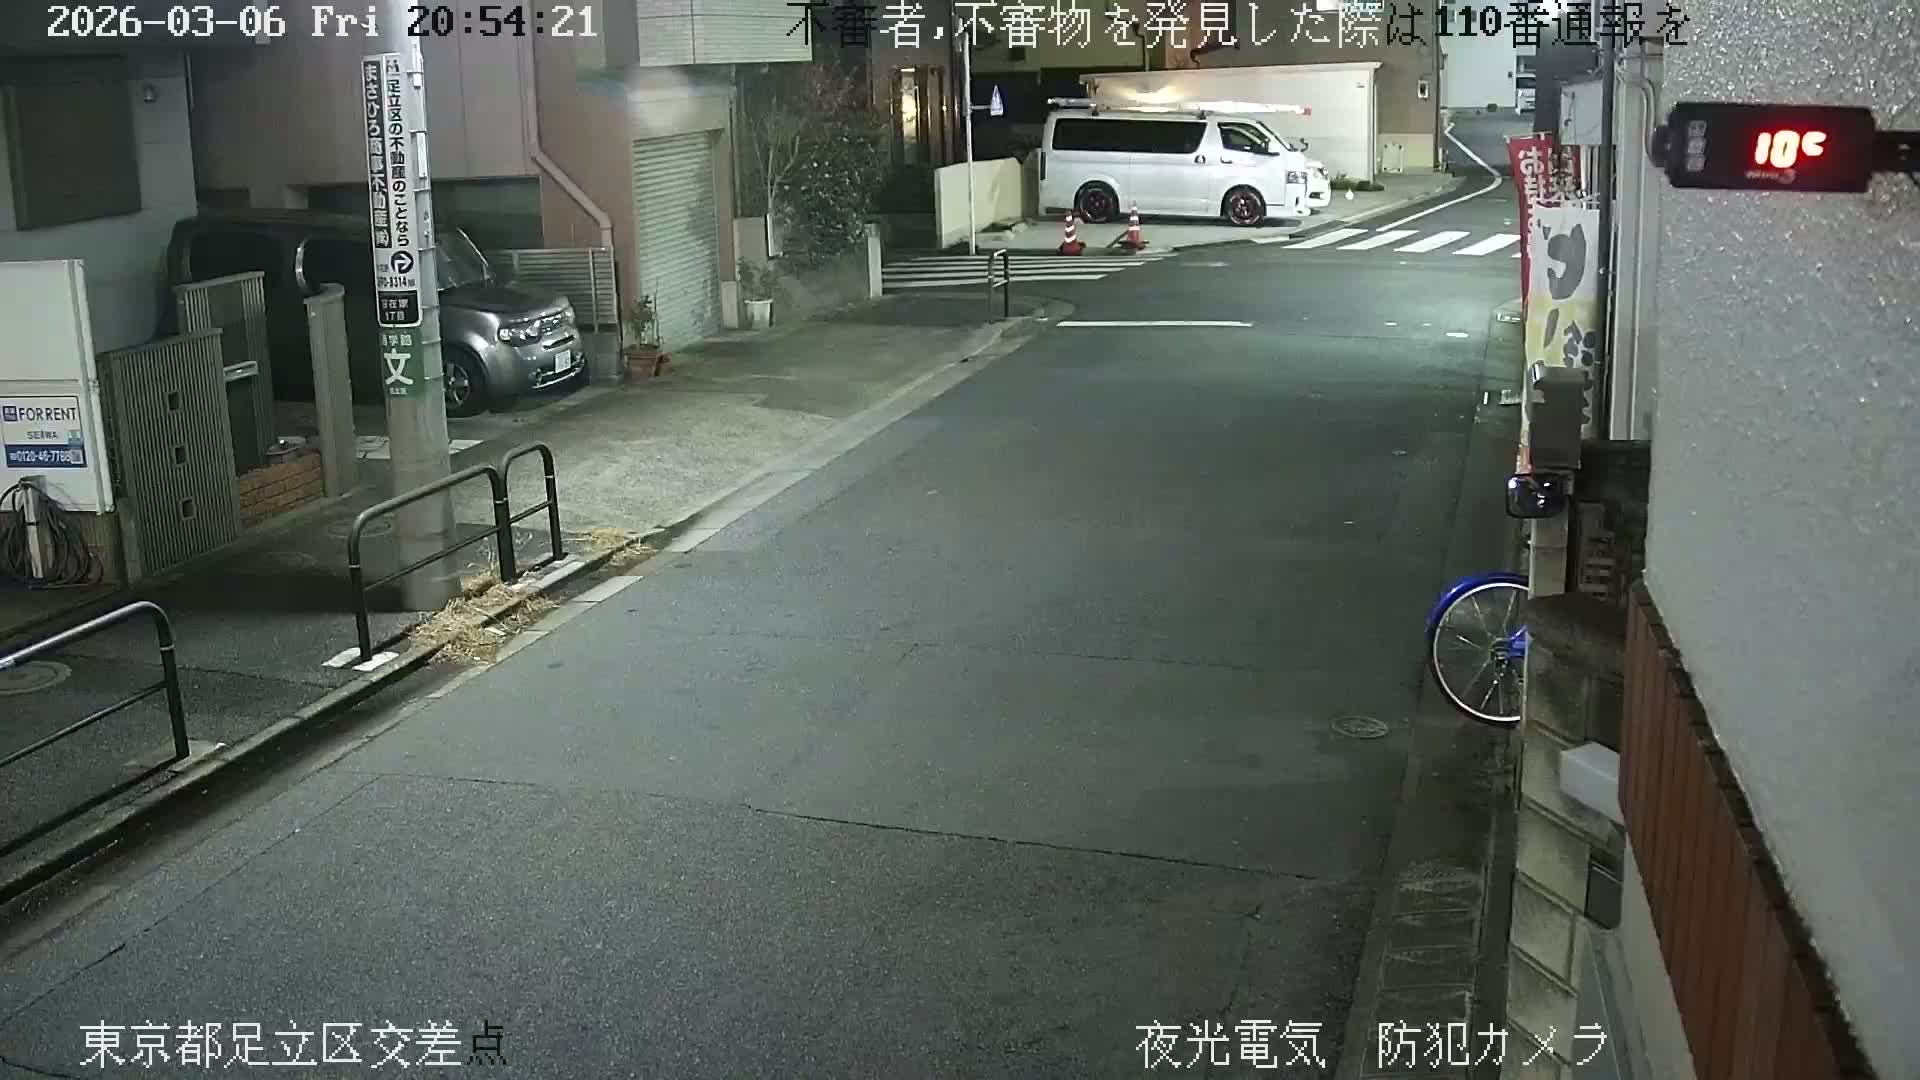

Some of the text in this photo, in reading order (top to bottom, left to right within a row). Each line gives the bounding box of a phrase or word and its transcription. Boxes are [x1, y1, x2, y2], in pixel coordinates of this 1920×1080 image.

[383, 347, 414, 385] 文
[18, 407, 43, 421] FOR
[46, 407, 77, 420] RENT
